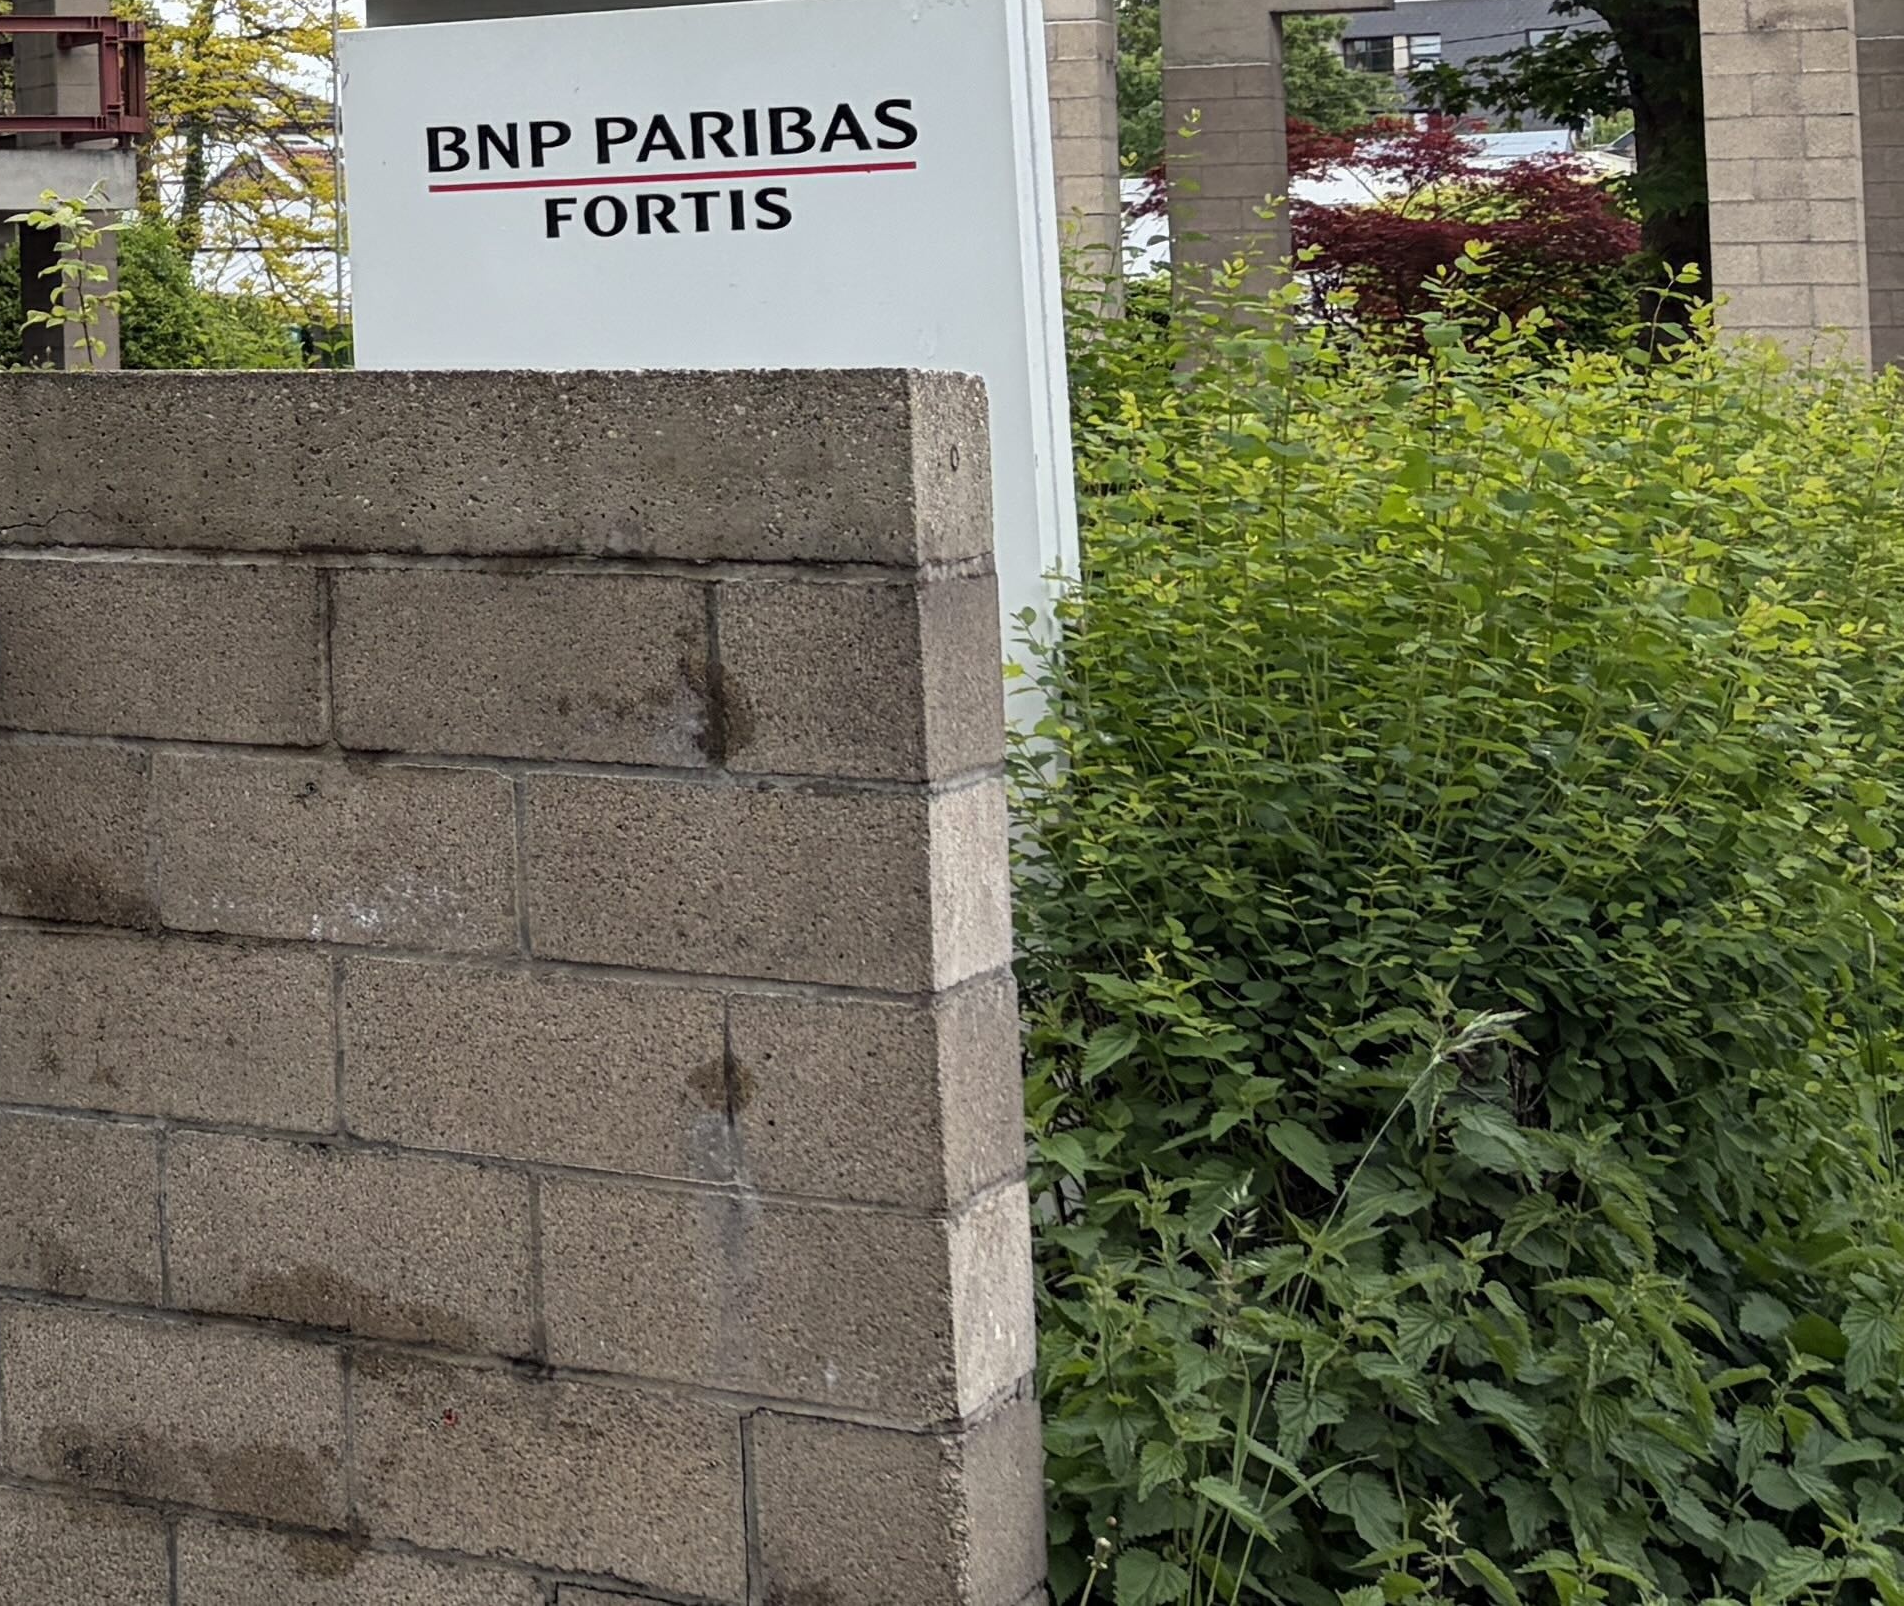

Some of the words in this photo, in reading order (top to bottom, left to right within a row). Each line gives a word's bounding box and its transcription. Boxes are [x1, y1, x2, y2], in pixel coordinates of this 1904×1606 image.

[425, 120, 572, 173] BNP
[595, 98, 919, 165] PARIBAS
[544, 186, 793, 239] FORTIS
